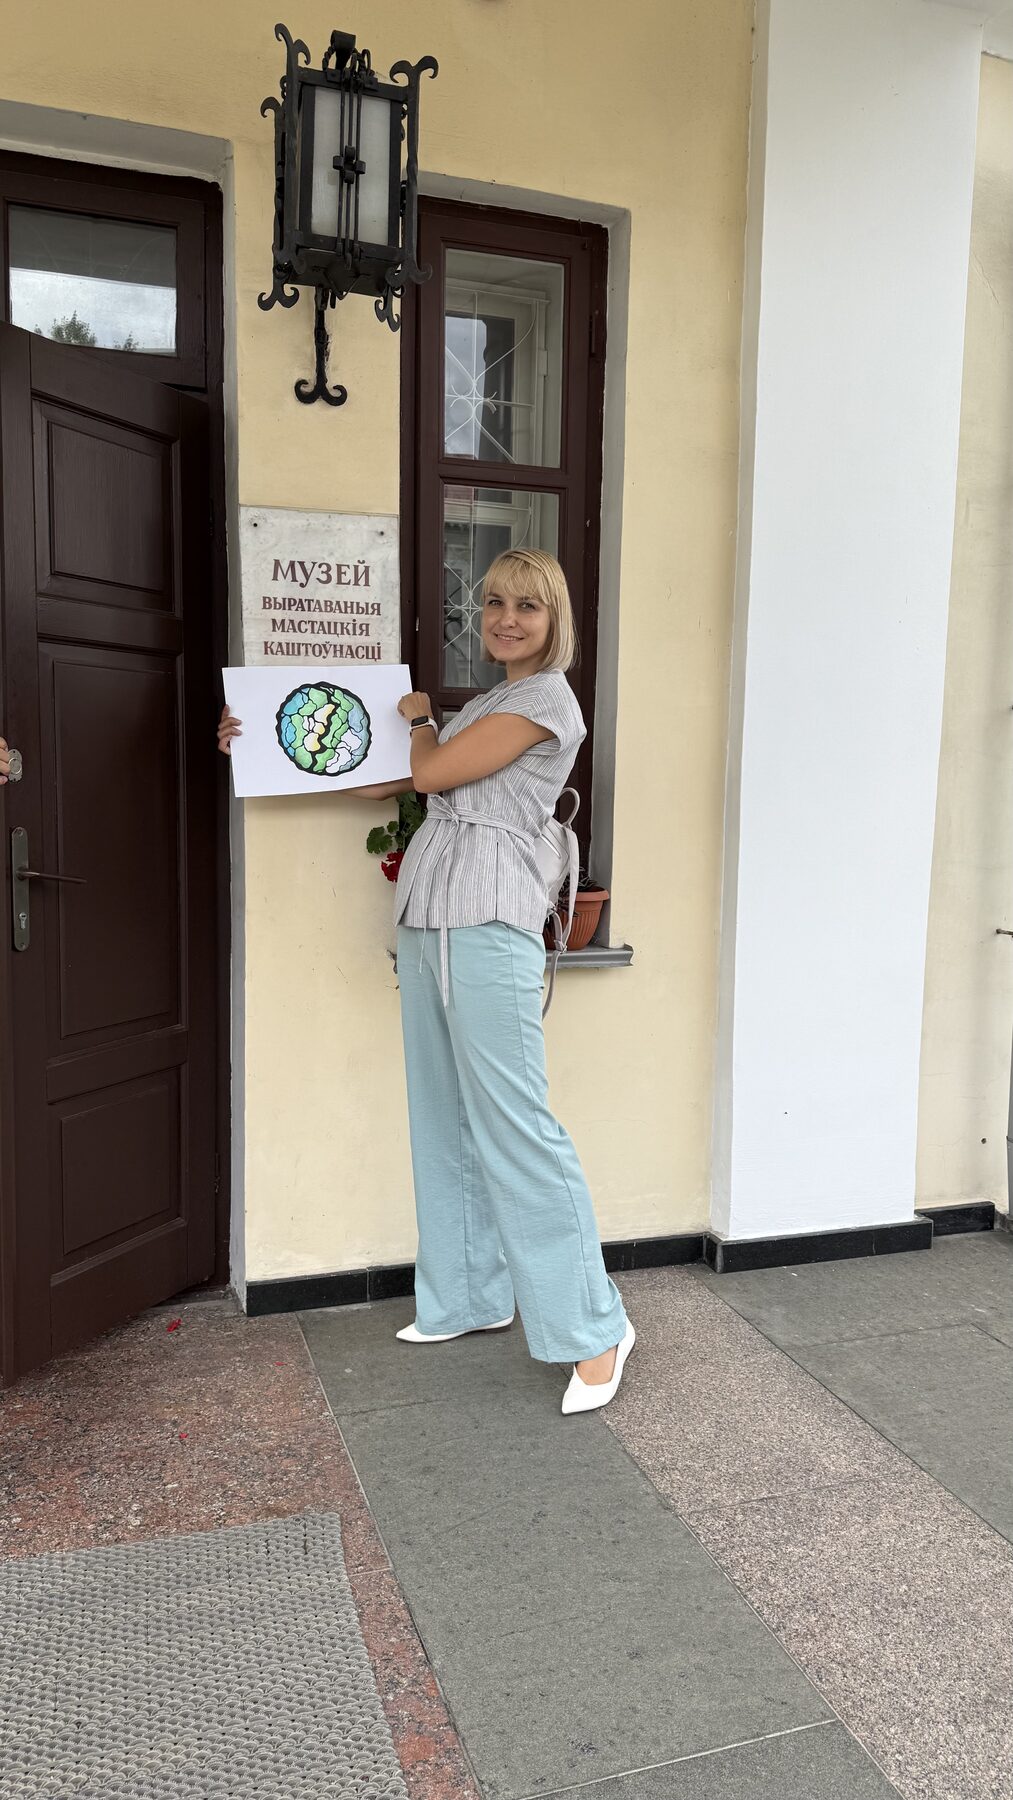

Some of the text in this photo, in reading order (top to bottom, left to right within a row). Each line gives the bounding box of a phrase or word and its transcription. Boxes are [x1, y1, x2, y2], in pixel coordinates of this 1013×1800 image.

[272, 559, 371, 588] МУЗЕЙ
[262, 596, 381, 616] ВЫРАТАВАНЫЯ
[271, 618, 370, 638] МАСТАЦКІЯ
[263, 641, 382, 662] КАШТОЎНАСЦІ
